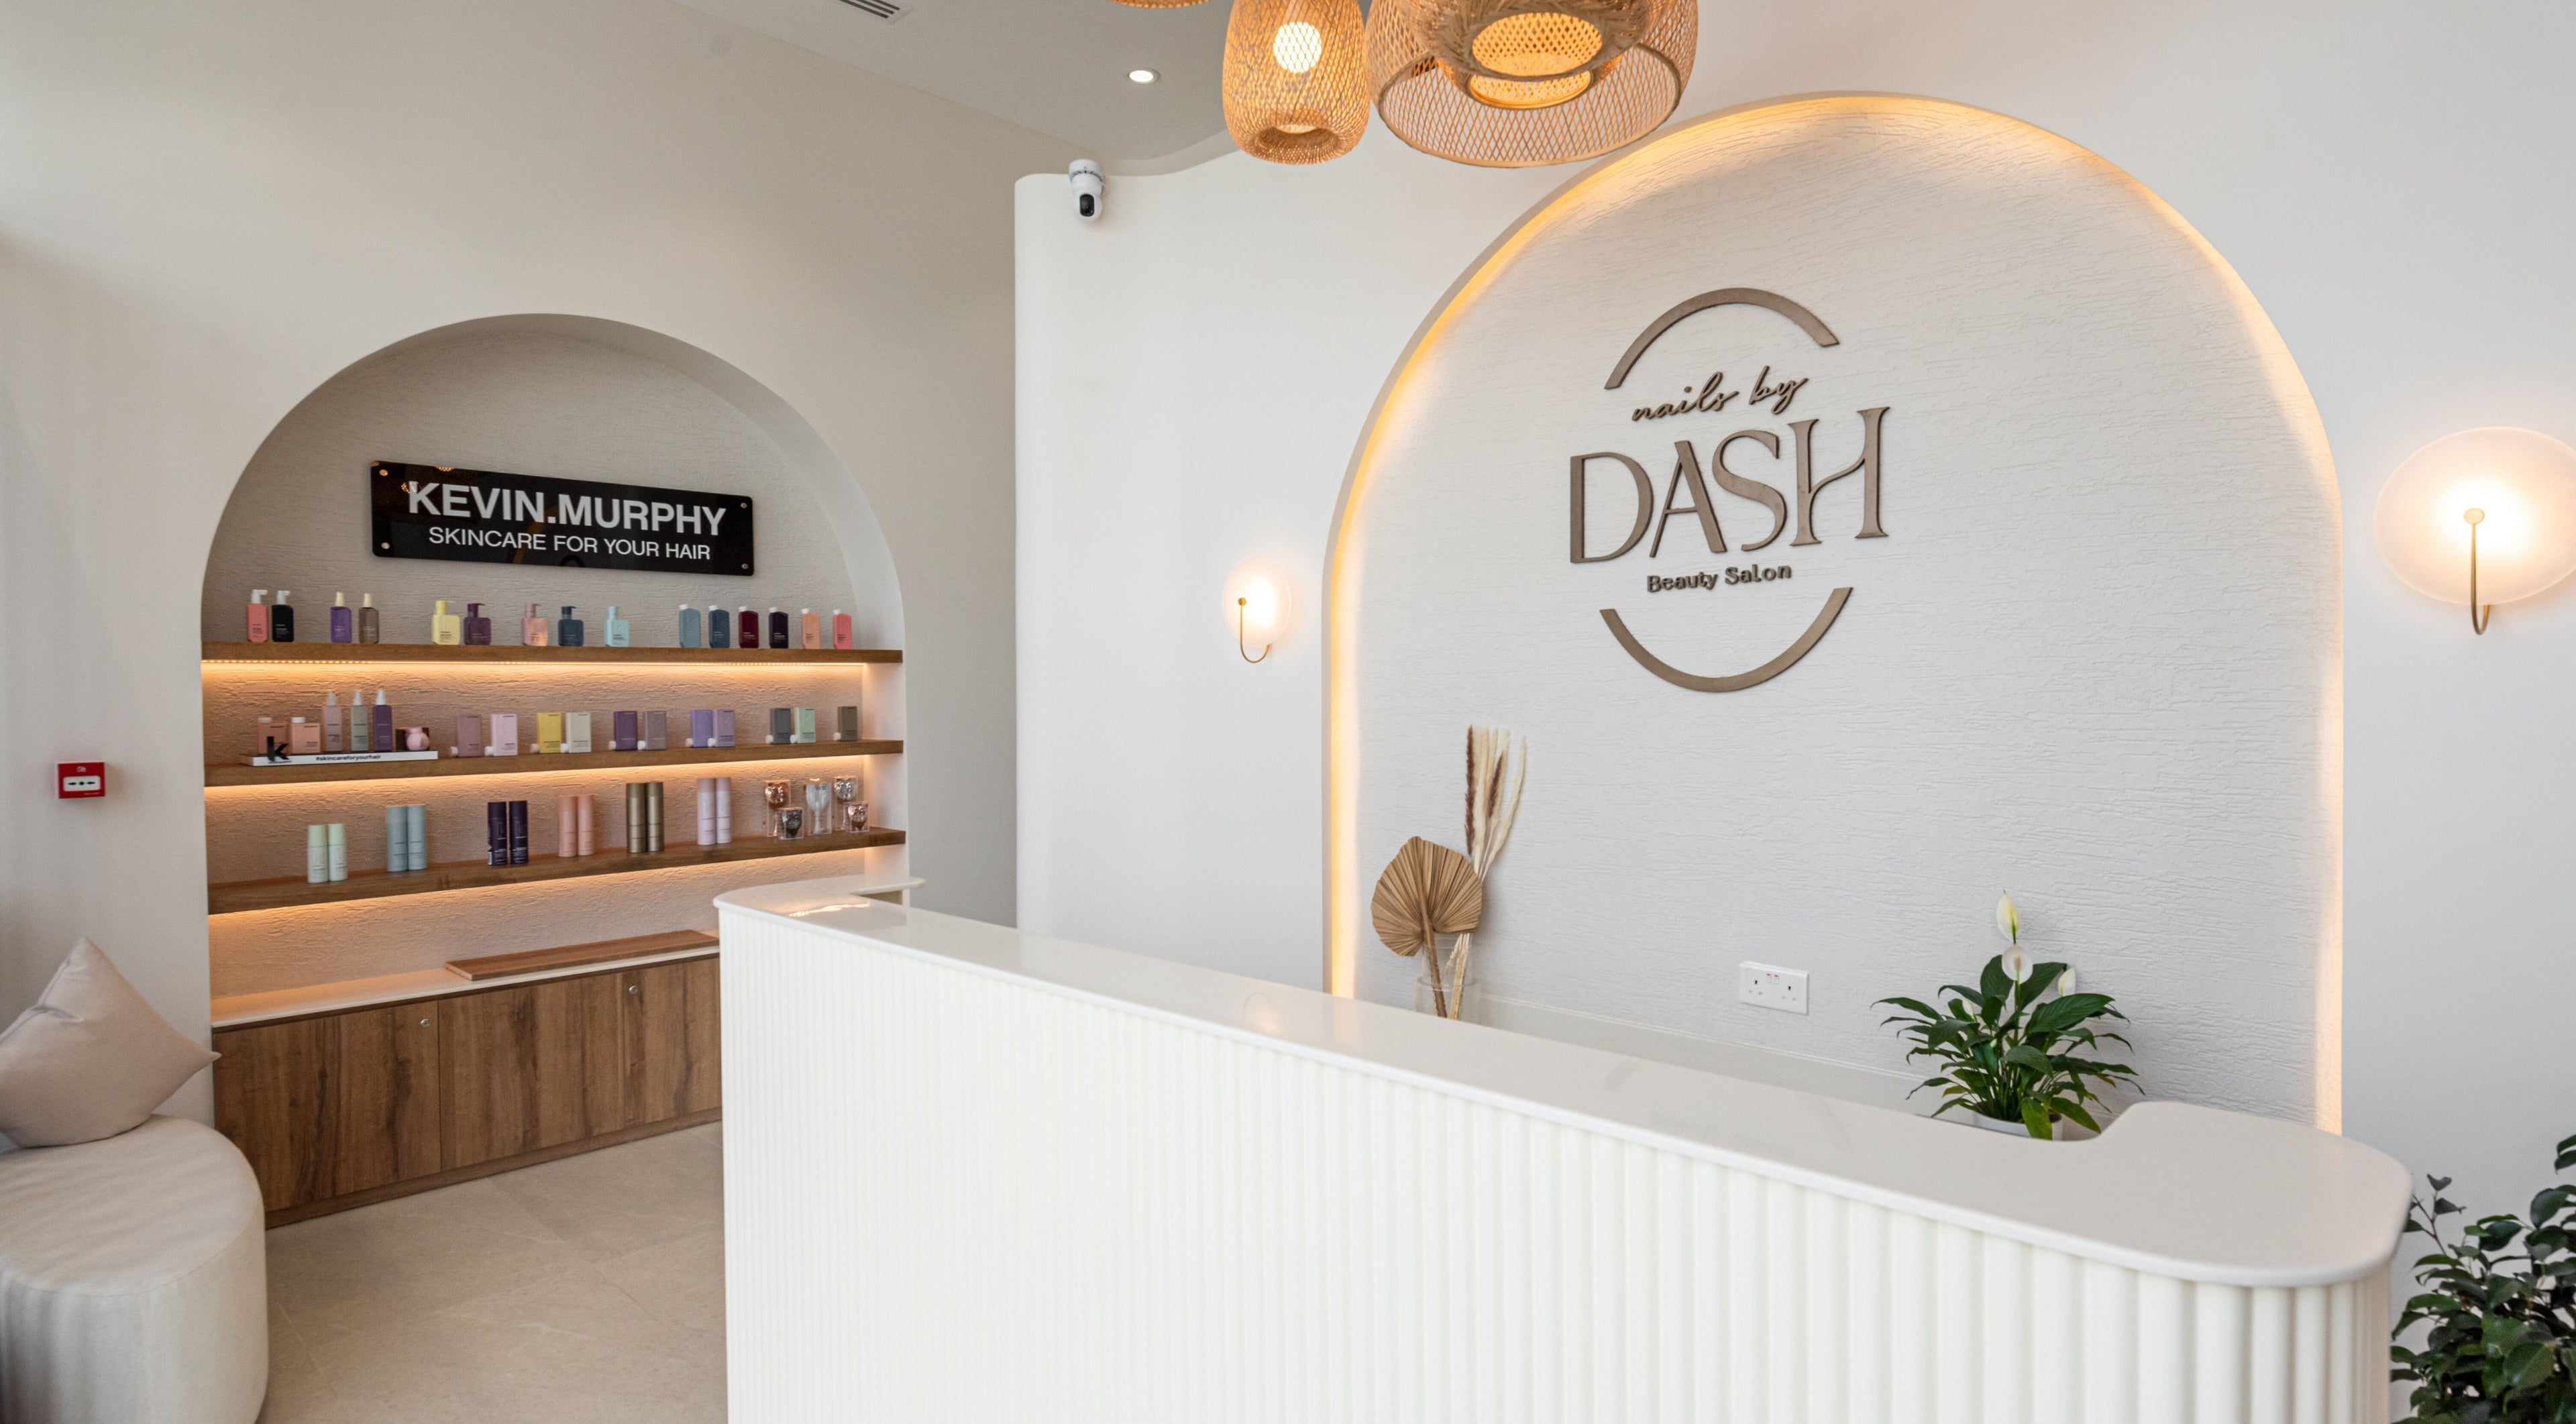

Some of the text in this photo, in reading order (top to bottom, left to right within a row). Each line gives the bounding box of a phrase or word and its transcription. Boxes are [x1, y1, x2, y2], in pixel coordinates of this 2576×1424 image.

[1631, 366, 1809, 421] nails by
[408, 481, 727, 536] KEVIN.MURPHY
[1570, 406, 1890, 563] DASH
[429, 527, 710, 560] SKINCARE FOR YOUR HAIR
[1647, 564, 1792, 593] Beauty Salon
